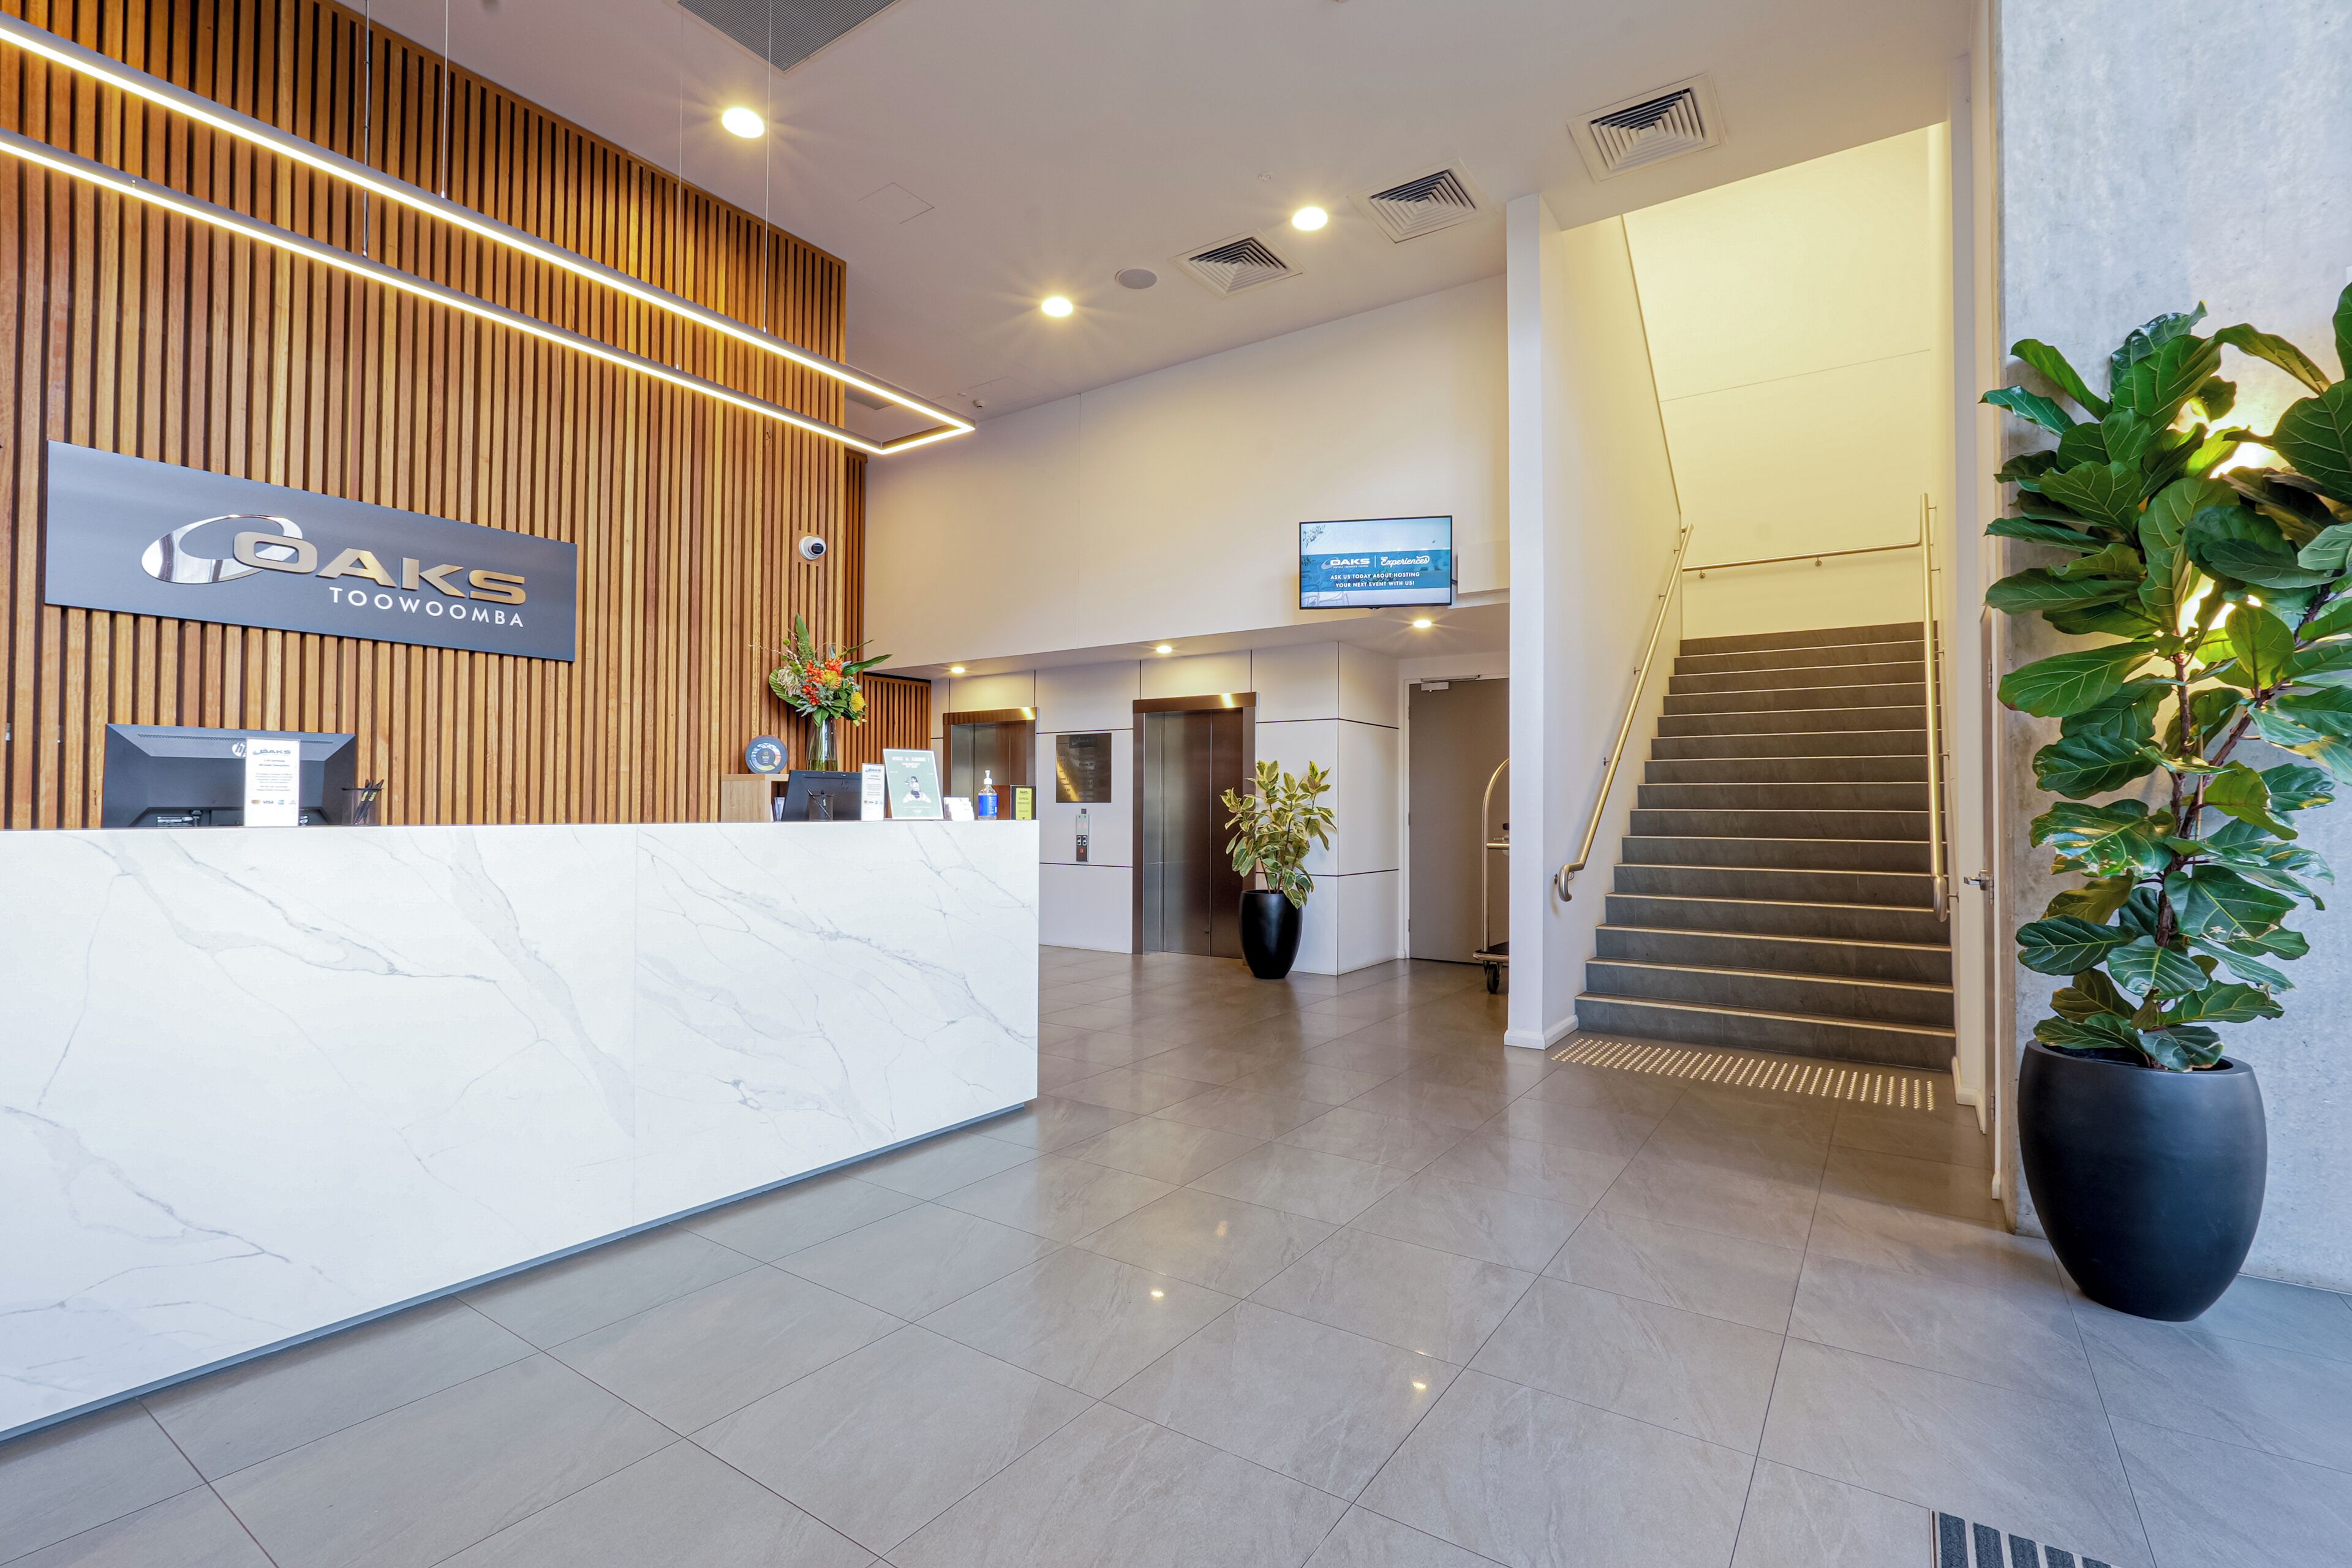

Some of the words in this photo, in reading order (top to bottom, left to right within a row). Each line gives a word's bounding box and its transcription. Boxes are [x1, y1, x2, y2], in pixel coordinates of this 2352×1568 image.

[233, 531, 527, 605] OAKS
[1381, 555, 1430, 568] Experiences
[329, 587, 524, 628] TOOWOOMBA
